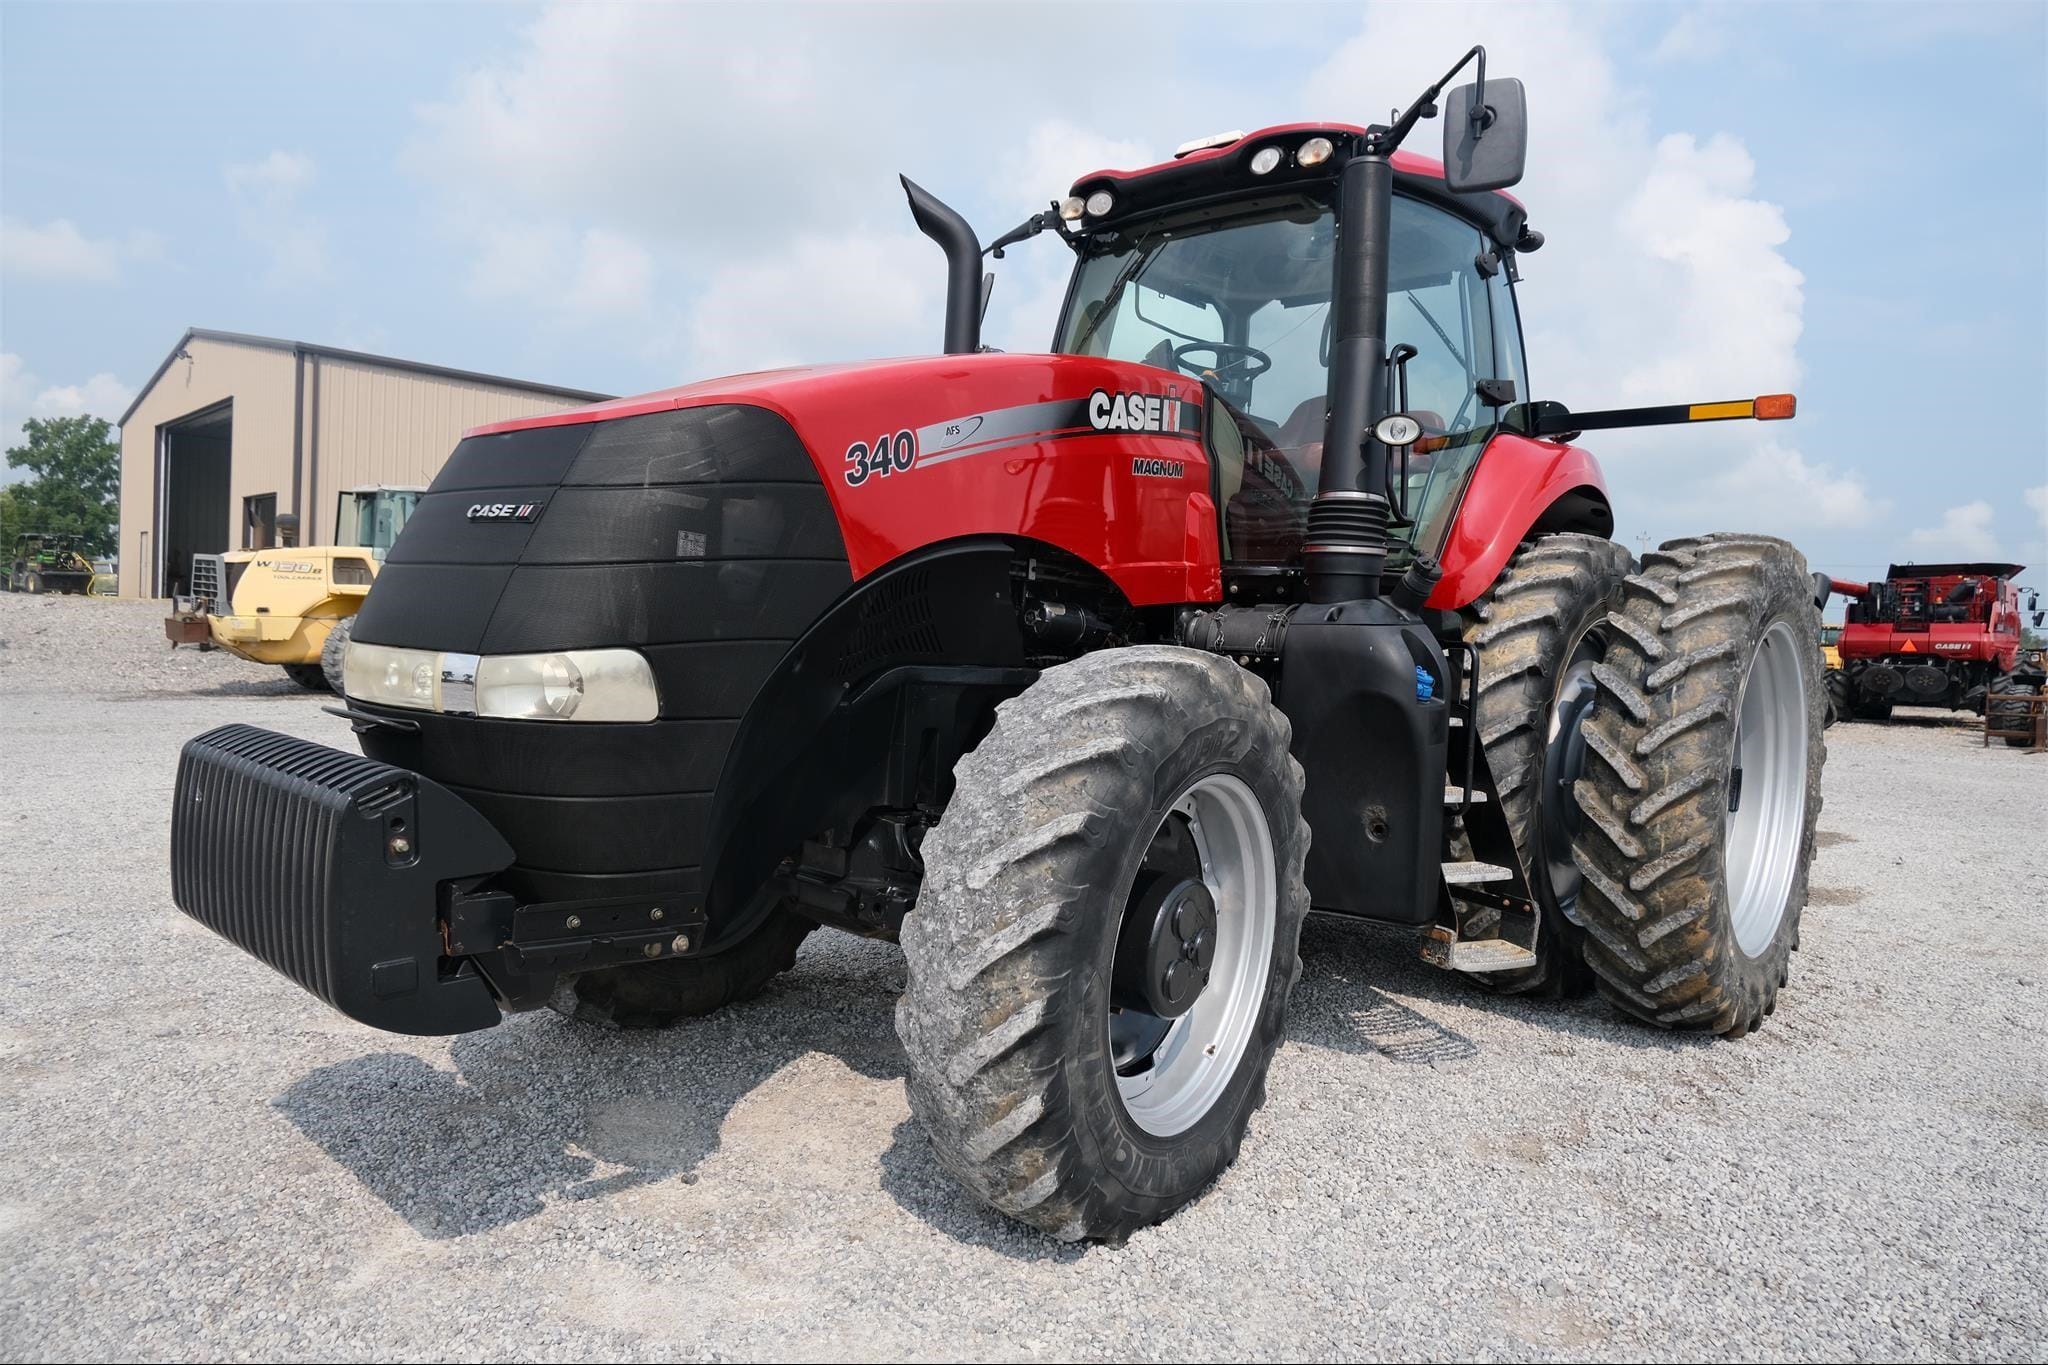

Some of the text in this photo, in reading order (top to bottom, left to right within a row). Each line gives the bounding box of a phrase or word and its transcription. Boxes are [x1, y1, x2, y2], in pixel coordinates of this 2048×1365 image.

[1089, 391, 1160, 431] CASE
[945, 425, 960, 436] AFS
[845, 429, 915, 487] 340
[1132, 458, 1184, 478] MAGNUM
[466, 503, 516, 518] CASE
